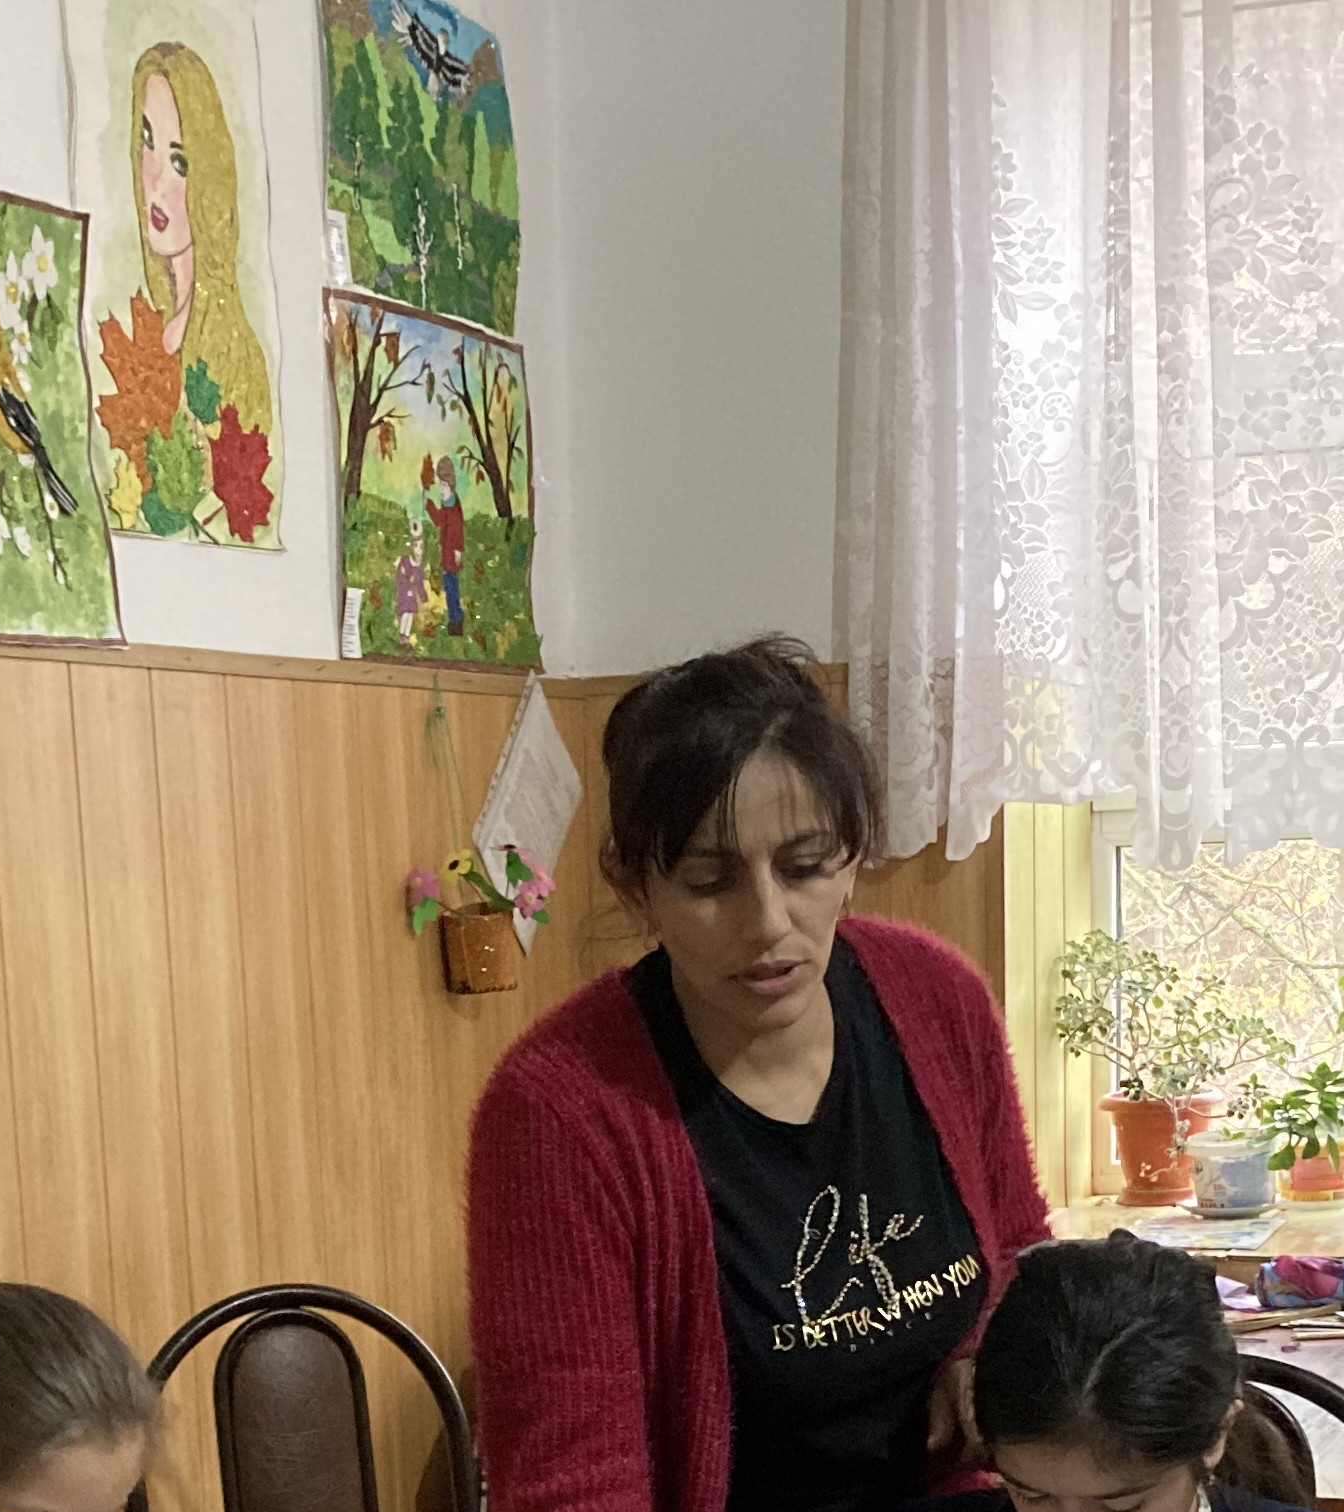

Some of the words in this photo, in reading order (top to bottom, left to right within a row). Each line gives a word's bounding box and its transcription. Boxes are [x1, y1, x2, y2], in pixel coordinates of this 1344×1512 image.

[772, 1323, 797, 1352] IS
[802, 1305, 885, 1349] BETTER
[877, 1273, 944, 1320] WHEN
[943, 1254, 981, 1298] YOU
